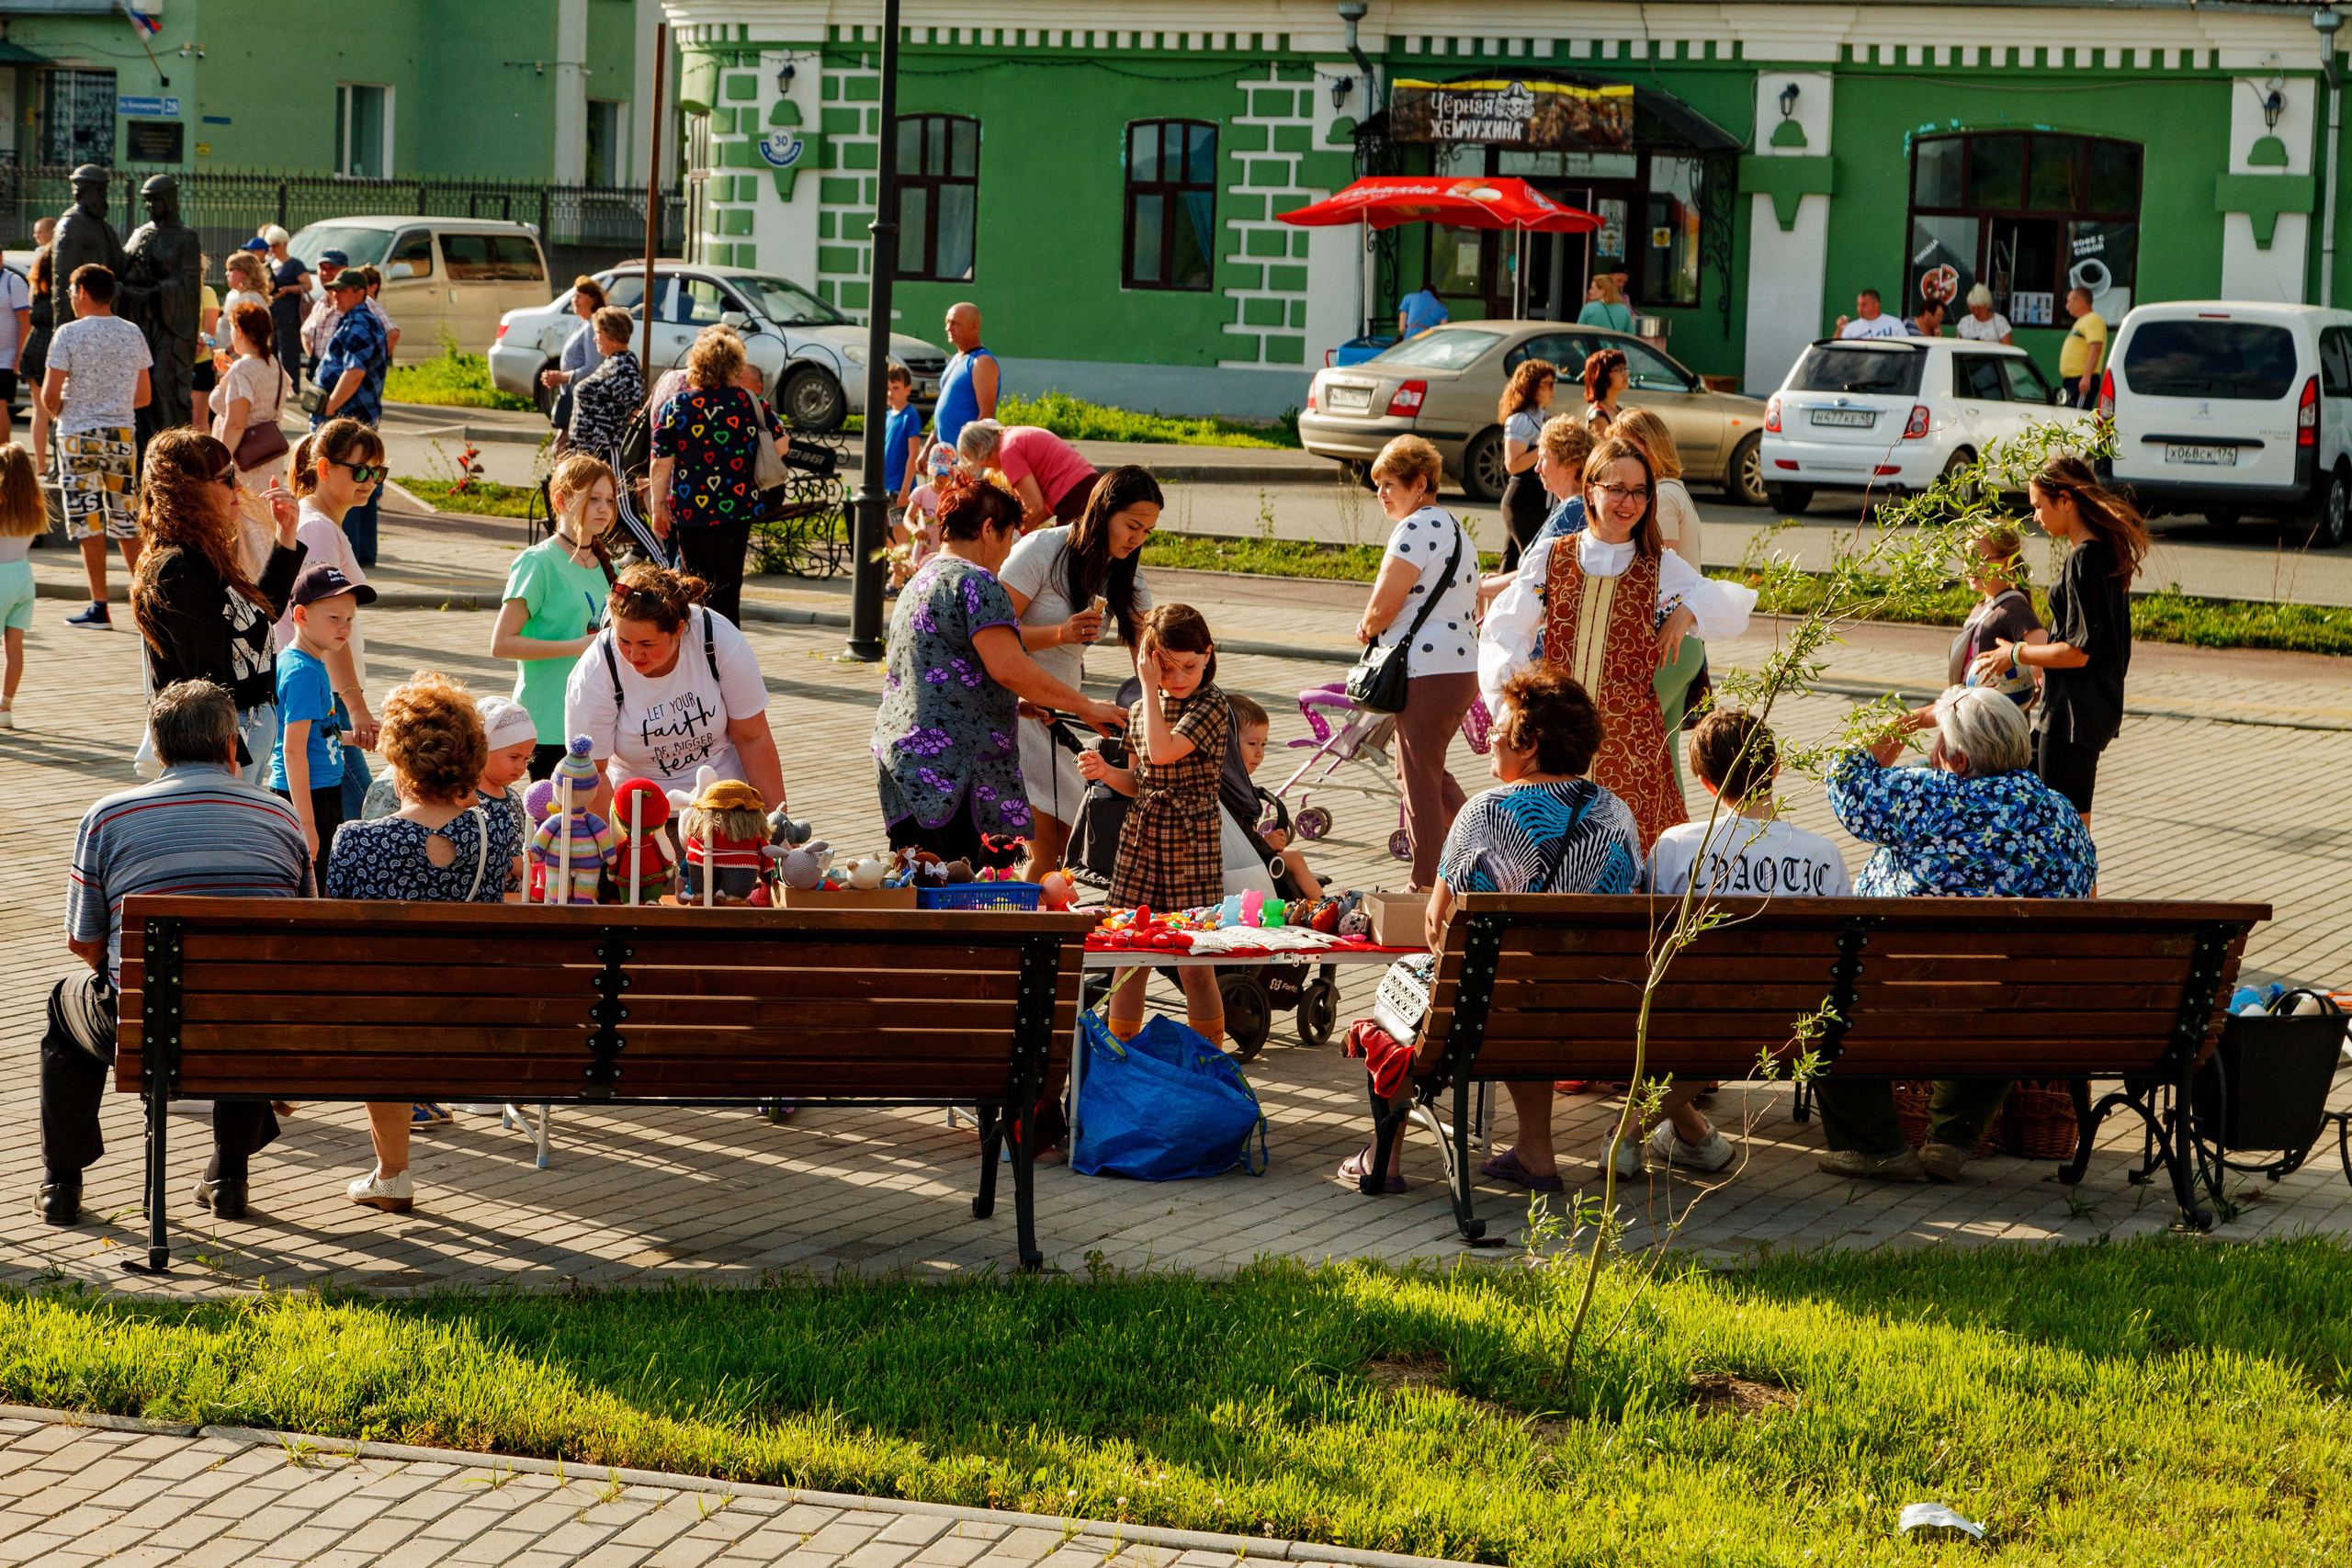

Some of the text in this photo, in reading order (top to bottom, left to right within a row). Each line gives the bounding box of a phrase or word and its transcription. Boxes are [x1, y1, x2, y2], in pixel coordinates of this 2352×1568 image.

[1430, 91, 1495, 119] Чёрная
[775, 135, 788, 147] 30
[1430, 119, 1521, 140] ЖЕМЧУЖИНА
[1914, 238, 1940, 265] ПИЦЦА
[2072, 237, 2097, 249] КОФЕ
[2074, 243, 2105, 257] СОБОЙ
[647, 692, 696, 722] LET YOUR
[640, 696, 716, 747] faith
[673, 733, 714, 752] BIGGER
[1689, 852, 1831, 897] CHAOTIC
